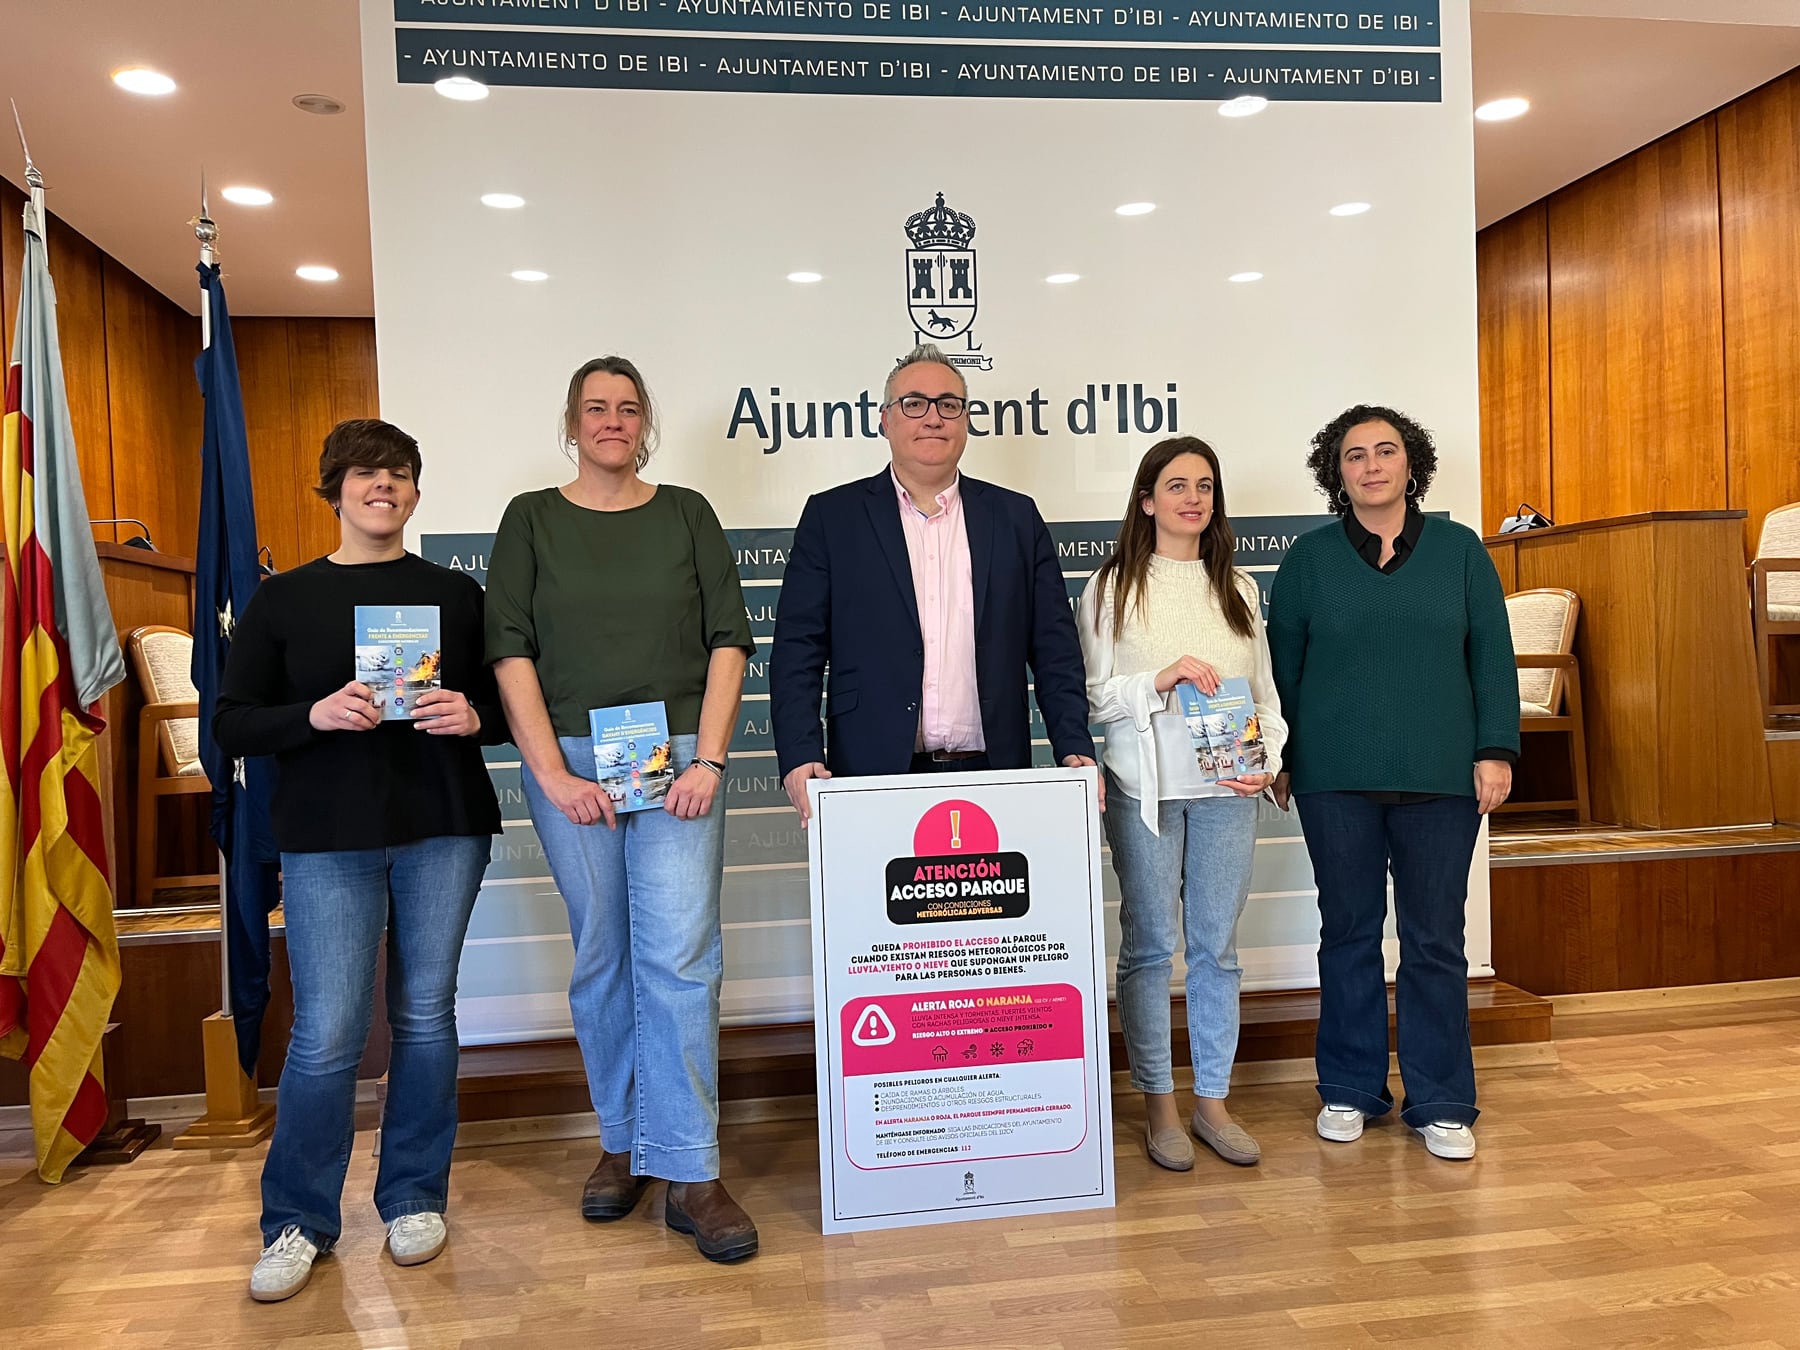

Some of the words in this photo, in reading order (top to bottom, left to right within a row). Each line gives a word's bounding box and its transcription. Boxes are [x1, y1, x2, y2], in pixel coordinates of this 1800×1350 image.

[677, 0, 853, 19] AYUNTAMIENTO
[864, 3, 891, 20] DE
[902, 4, 929, 21] IBI
[958, 6, 1103, 25] AJUNTAMENT
[1114, 7, 1163, 26] D'IBI
[1188, 11, 1348, 30] AYUNTAMIENTO
[1358, 14, 1385, 30] DE
[1394, 15, 1418, 31] IBI
[422, 48, 607, 70] AYUNTAMIENTO
[619, 54, 647, 72] DE
[659, 55, 689, 73] IBI
[717, 57, 869, 78] AJUNTAMENT
[880, 60, 930, 79] D'IBI
[958, 63, 1124, 82] AYUNTAMIENTO
[1135, 66, 1160, 83] DE
[1170, 67, 1197, 84] IBI
[1224, 68, 1363, 85] AJUNTAMENT
[1374, 68, 1420, 86] D'IBI
[726, 386, 1049, 454] Ajuntent
[1067, 382, 1178, 434] d'Ibi
[914, 858, 1001, 881] ATENCIÓN
[890, 882, 958, 901] ACCESO
[961, 878, 1025, 897] PARQUE
[917, 907, 967, 918] METEORÓLICAS
[968, 906, 1003, 915] ADVERSAS
[928, 902, 943, 910] CON
[944, 899, 991, 909] CONDICIONES
[872, 943, 901, 952] QUEDA
[903, 940, 952, 950] PROHIBIDO
[955, 939, 963, 947] EL
[965, 937, 999, 946] ACCESO
[1001, 936, 1011, 944] AL
[1013, 933, 1047, 943] PARQUE
[851, 954, 888, 964] CUANDO
[890, 951, 926, 961] EXISTAN
[929, 949, 967, 959] RIESGOS
[968, 943, 1046, 956] METEOROLÓGICOS
[1048, 942, 1065, 951] POR
[915, 962, 921, 970] O
[923, 960, 949, 969] NIEVE
[951, 959, 967, 967] QUE
[970, 956, 1017, 966] SUPONGAN
[1019, 955, 1031, 963] UN
[1033, 952, 1069, 962] PELIGRO
[895, 973, 918, 981] PARA
[920, 971, 936, 980] LAS
[938, 968, 983, 979] PERSONAS
[985, 967, 991, 975] O
[993, 965, 1026, 975] BIENES.
[911, 1000, 947, 1012] ALERTA
[948, 998, 975, 1010] ROJA
[976, 997, 984, 1008] O
[986, 994, 1032, 1006] NARANJA
[911, 1014, 932, 1022] LLUVIA
[934, 1012, 958, 1020] INTENSA
[1002, 1007, 1026, 1016] FUERTES
[1027, 1006, 1052, 1014] VIENTOS
[927, 1020, 951, 1028] RACHAS
[953, 1017, 989, 1026] PELIGROSAS
[912, 1031, 935, 1039] RIESGO
[957, 1027, 983, 1036] EXTREMO
[990, 1025, 1013, 1033] ACCESO
[1014, 1023, 1047, 1032] PROHIBIDO
[874, 1080, 903, 1088] POSIBLES
[904, 1077, 933, 1086] PELIGROS
[944, 1074, 977, 1083] CUALQUIER
[881, 1096, 926, 1105] INUNDACIONES
[934, 1091, 977, 1101] ACUMULACIÓN
[910, 1088, 930, 1096] RAMAS
[881, 1101, 940, 1112] DESPRENDIMIENTOS
[947, 1099, 966, 1107] OTROS
[968, 1096, 993, 1105] RIESGOS
[904, 1116, 930, 1124] NARANJA
[960, 1111, 981, 1119] PARQUE
[982, 1109, 1005, 1117] SIEMPRE
[1006, 1105, 1044, 1114] PERMANECERÁ
[876, 1131, 911, 1139] MANTÉNGASE
[962, 1124, 971, 1132] LAS
[972, 1122, 1011, 1131] INDICACIONES
[1022, 1118, 1062, 1127] AYUNTAMIENTO
[938, 1133, 958, 1141] AVISOS
[960, 1129, 987, 1139] OFICIALES
[876, 1150, 906, 1158] TELÉFONO
